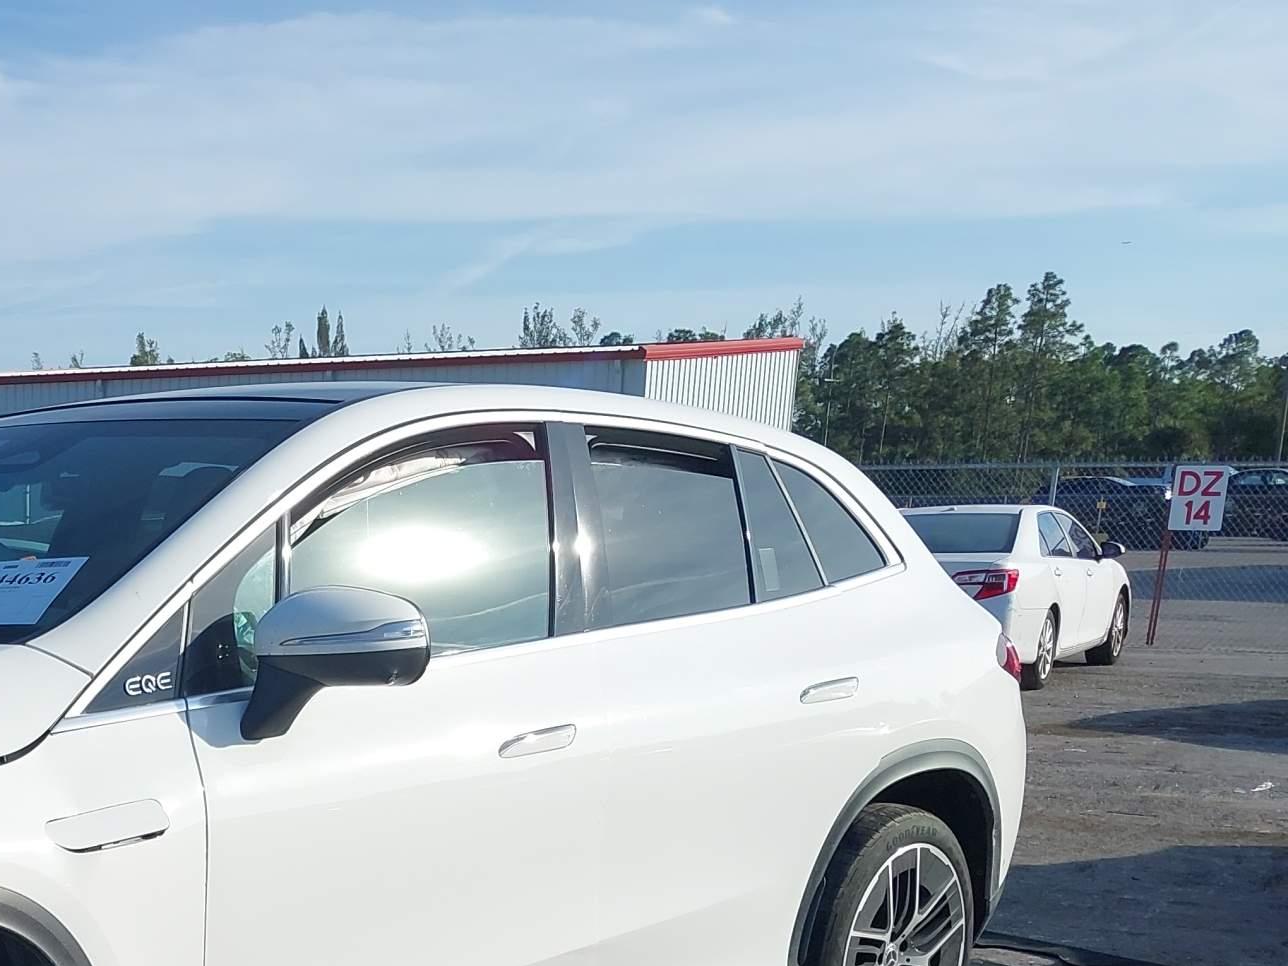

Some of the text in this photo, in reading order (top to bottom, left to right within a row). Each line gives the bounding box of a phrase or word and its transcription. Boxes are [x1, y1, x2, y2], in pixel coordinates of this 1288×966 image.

[1178, 471, 1224, 496] DZ
[1184, 500, 1211, 525] 14
[125, 671, 172, 696] EQE
